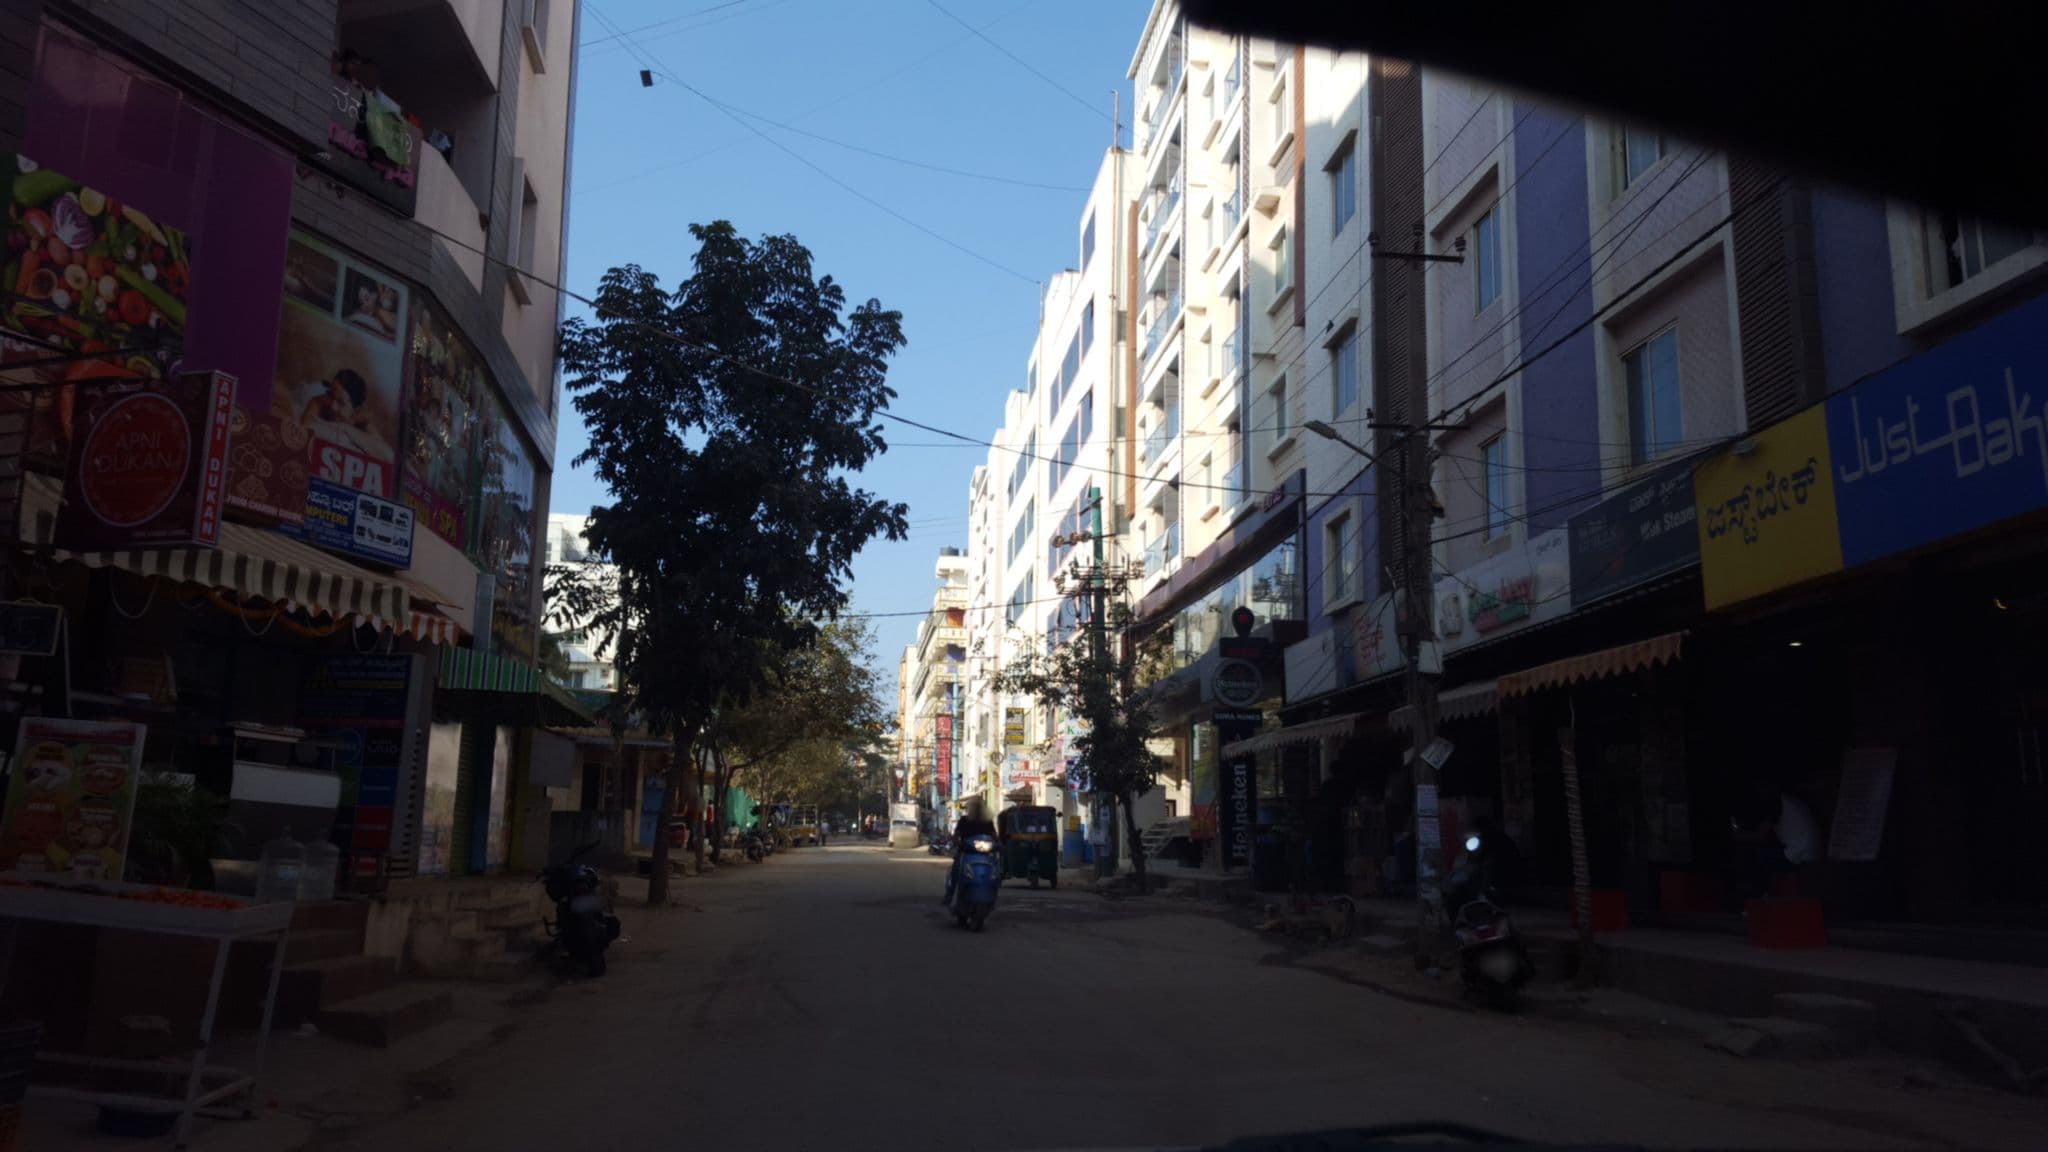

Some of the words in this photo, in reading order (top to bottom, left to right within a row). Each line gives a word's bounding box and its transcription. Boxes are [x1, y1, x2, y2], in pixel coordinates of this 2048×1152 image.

[117, 431, 161, 449] APNI
[215, 379, 233, 441] APNI
[1841, 395, 1948, 483] Just
[1946, 366, 2048, 480] Bak
[96, 450, 172, 472] DUKAN
[319, 447, 384, 498] SPA
[202, 457, 221, 536] DUKAN
[1232, 764, 1248, 857] Heineken
